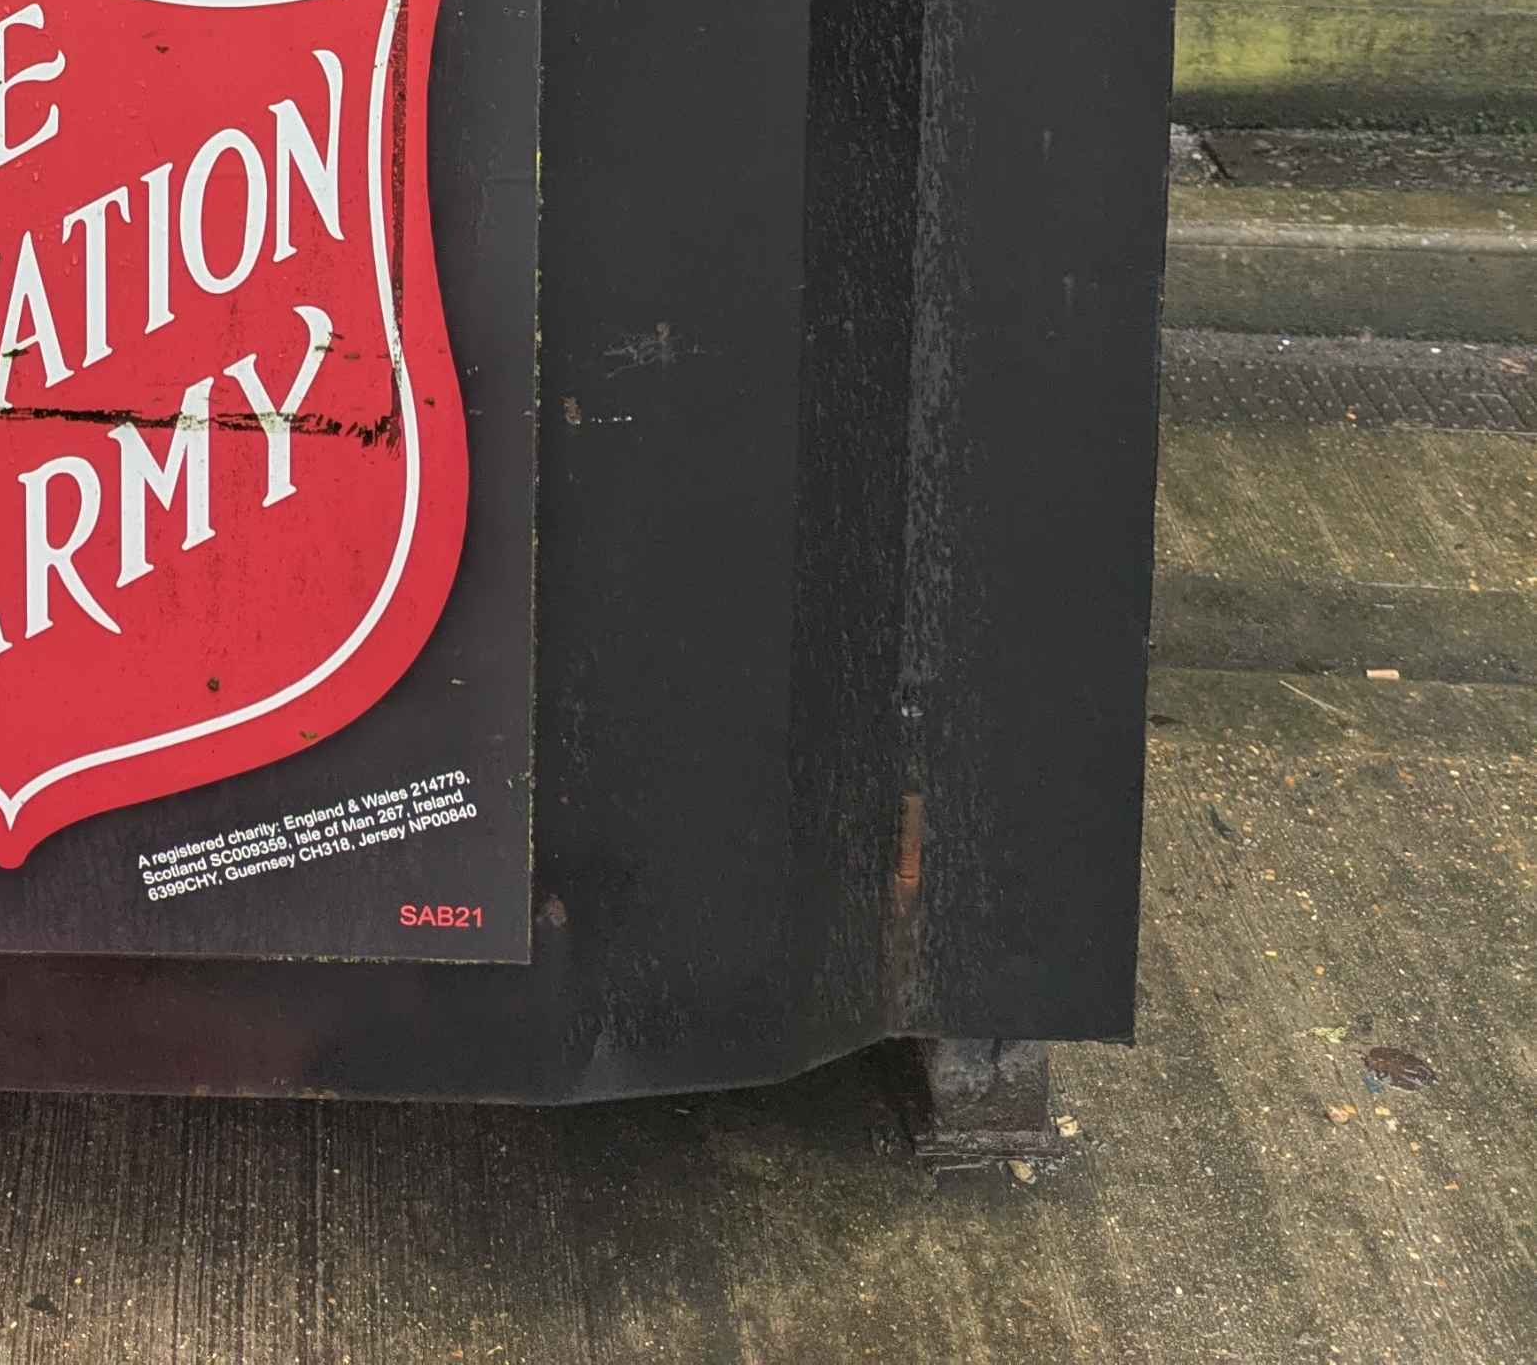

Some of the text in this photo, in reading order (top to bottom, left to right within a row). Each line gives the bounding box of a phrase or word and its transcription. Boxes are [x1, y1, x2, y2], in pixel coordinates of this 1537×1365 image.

[151, 832, 226, 866] registered
[226, 820, 282, 846] charity:
[282, 801, 347, 832] England
[347, 798, 362, 815] &
[360, 787, 410, 811] Wales
[224, 852, 297, 882] Guernsey
[357, 823, 407, 848] Jersey
[408, 802, 479, 835] NP00840
[398, 903, 484, 930] SAB21
